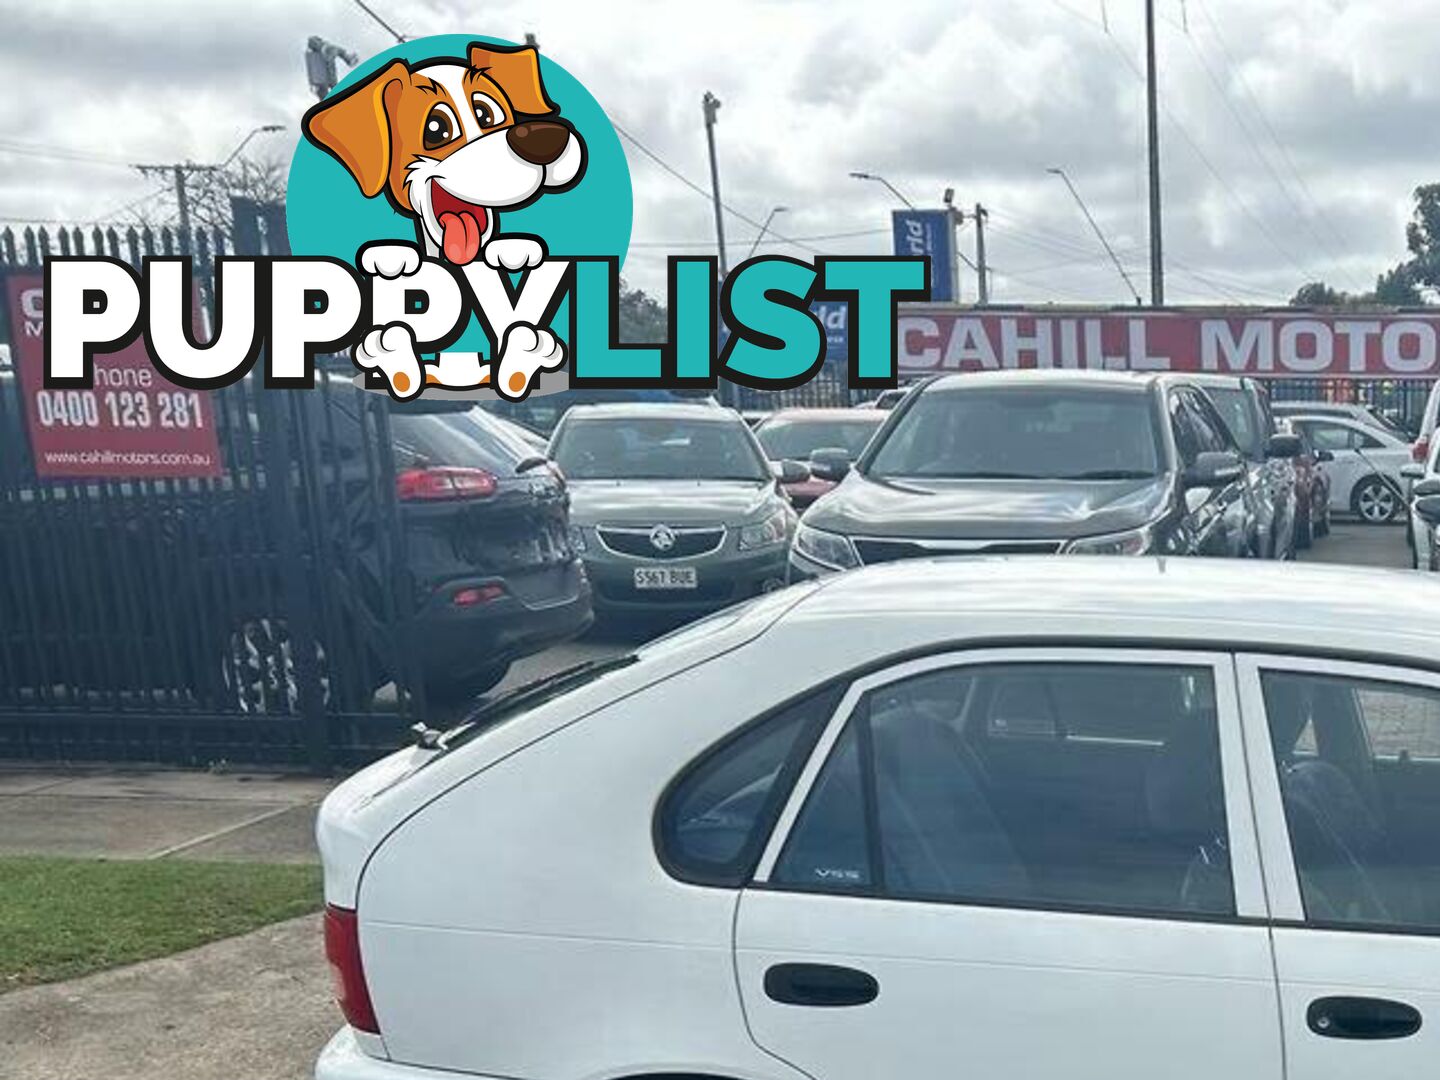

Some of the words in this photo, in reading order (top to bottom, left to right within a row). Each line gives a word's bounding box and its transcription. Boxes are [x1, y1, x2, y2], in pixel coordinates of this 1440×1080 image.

[898, 316, 1172, 371] CAHILL
[93, 361, 153, 387] hone
[36, 390, 99, 428] 0400
[105, 391, 151, 428] 123
[157, 391, 203, 429] 281
[44, 450, 211, 466] www.cahillmotors.com.au
